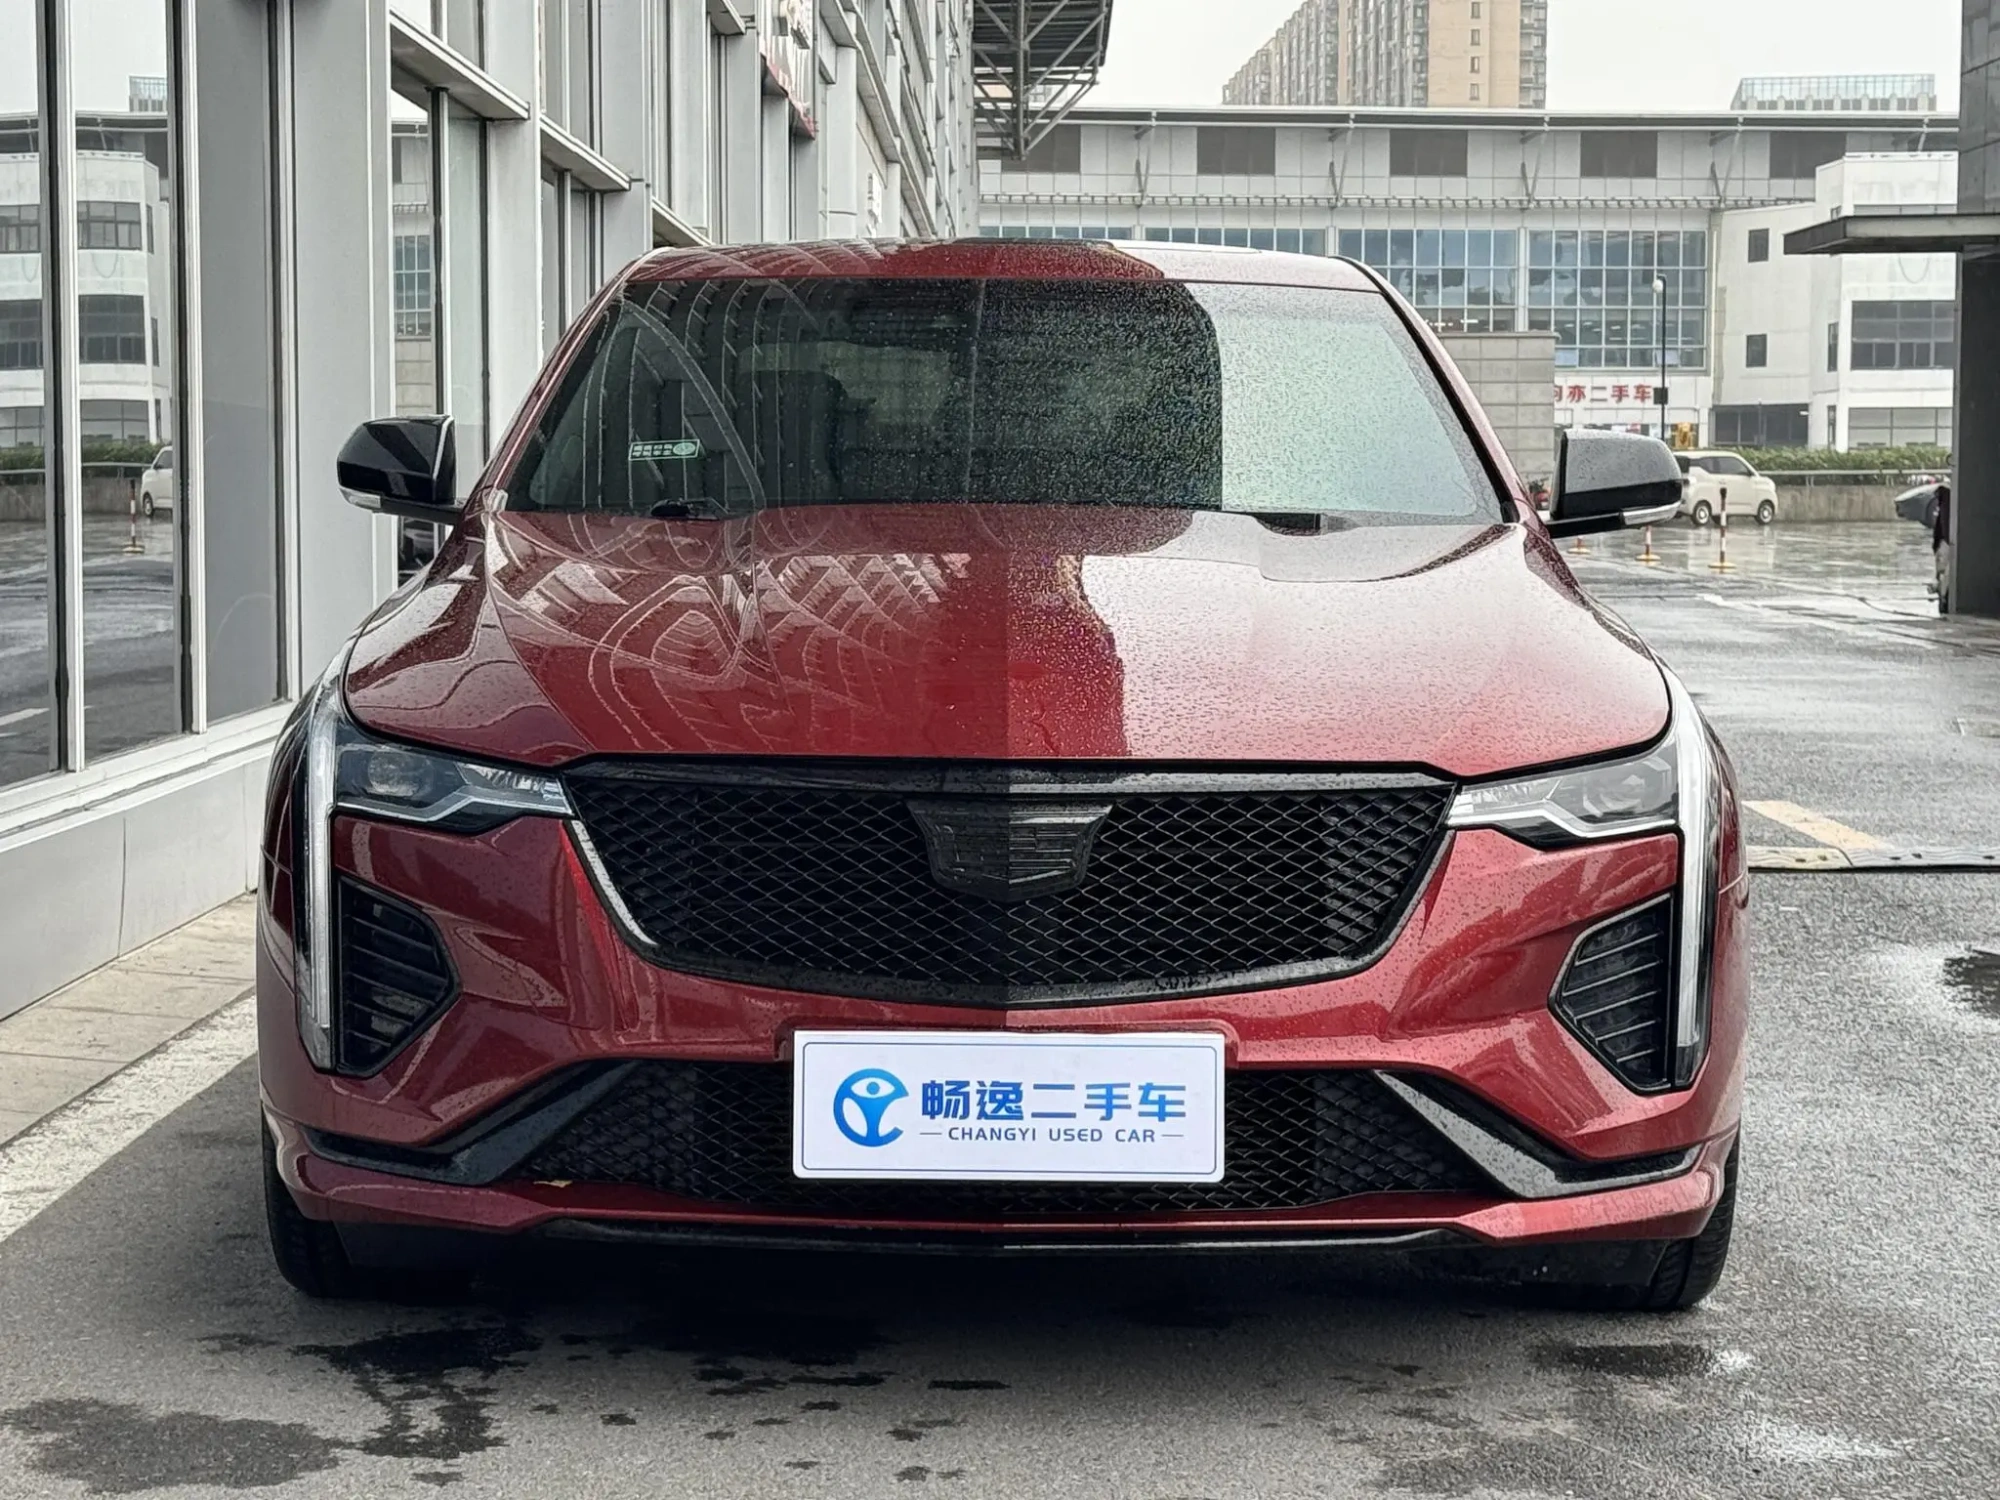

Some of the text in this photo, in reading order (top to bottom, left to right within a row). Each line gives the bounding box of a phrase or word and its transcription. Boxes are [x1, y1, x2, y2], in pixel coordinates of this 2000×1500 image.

[921, 1080, 1187, 1122] 畅逸二手车
[948, 1126, 1156, 1143] CHANGYI USED CAR
